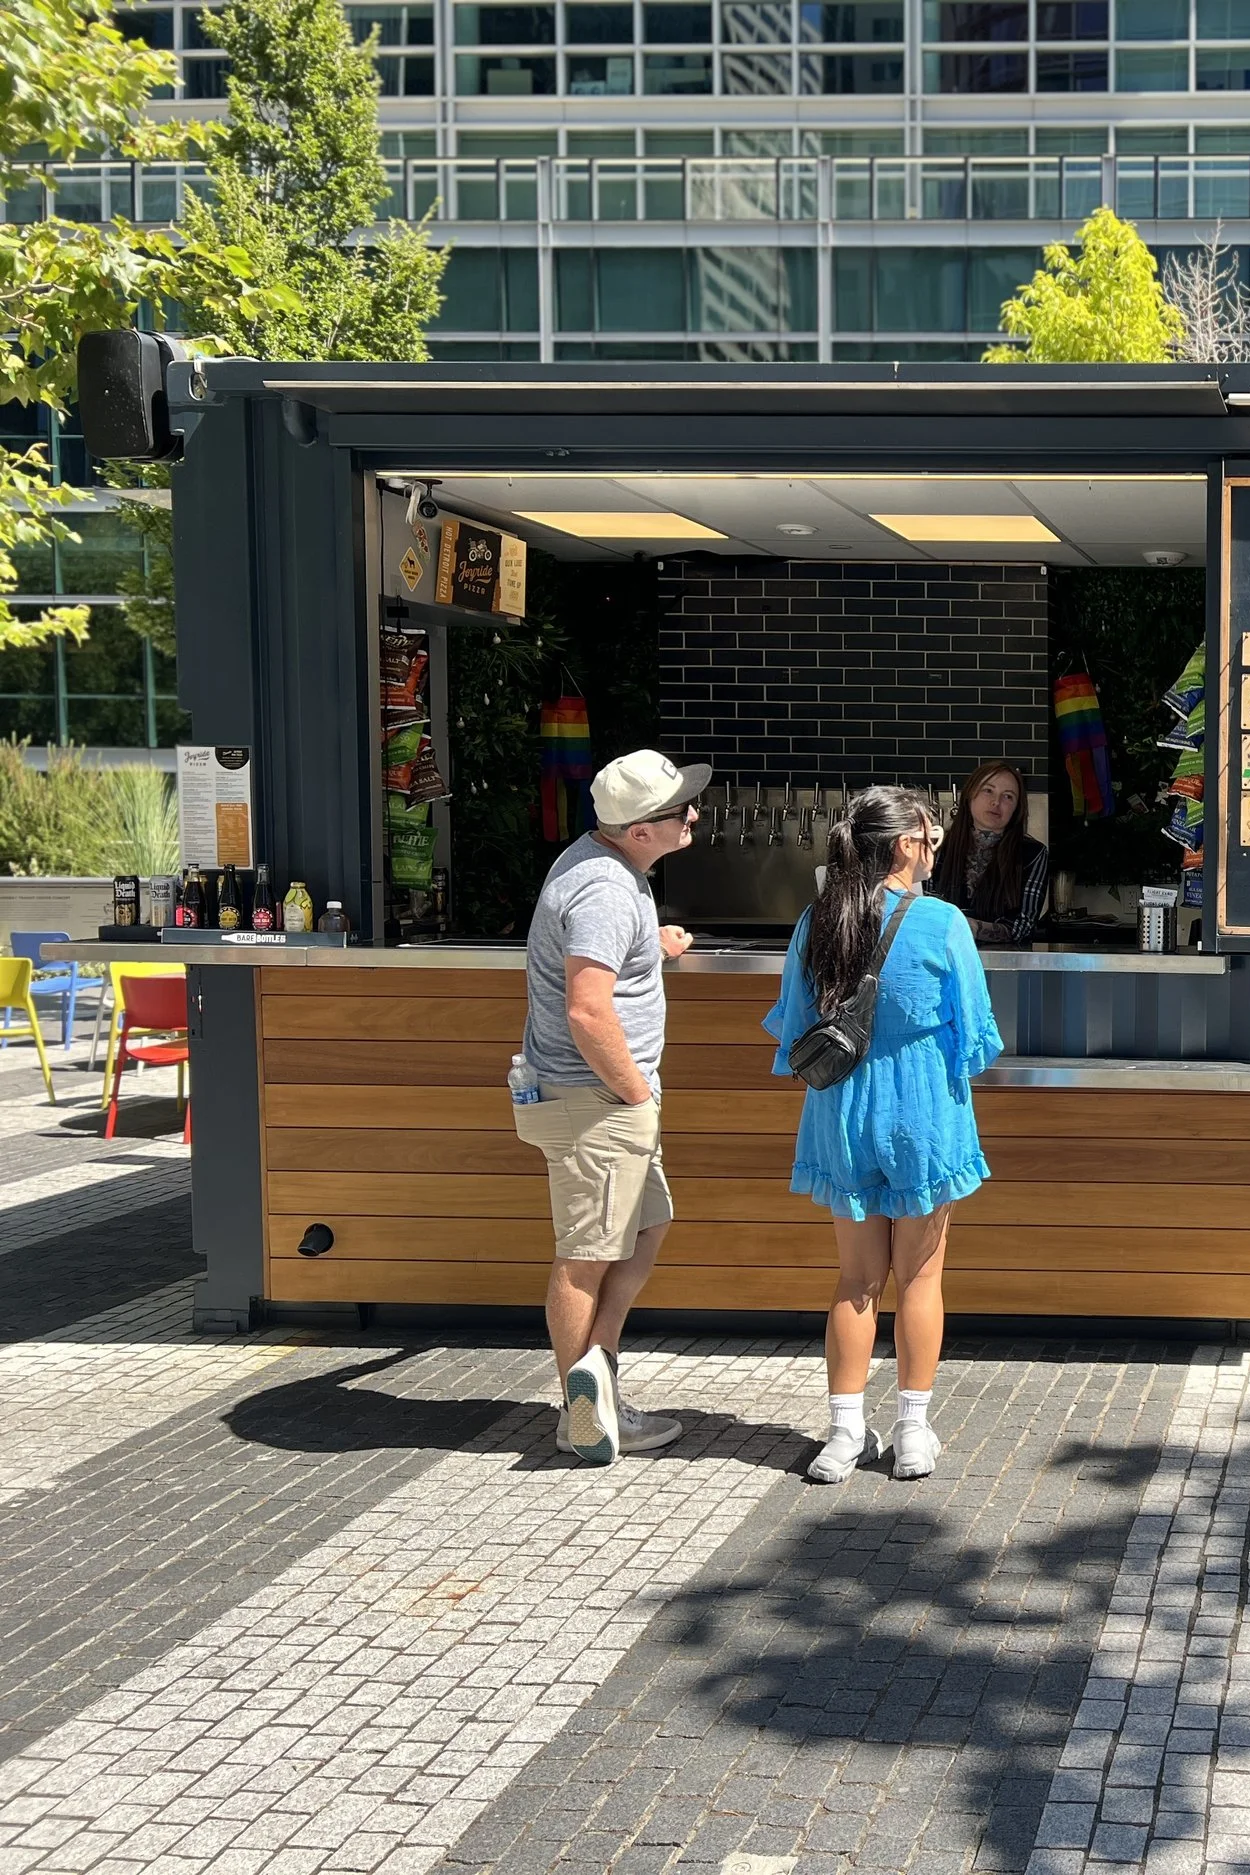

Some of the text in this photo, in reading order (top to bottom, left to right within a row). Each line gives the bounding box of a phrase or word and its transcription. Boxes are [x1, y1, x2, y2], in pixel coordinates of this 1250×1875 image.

[439, 526, 453, 598] HOT DETROIT PIZZA
[457, 560, 493, 583] Joyride
[463, 583, 486, 595] PIZZA
[114, 881, 136, 891] Liquid
[150, 883, 170, 892] Liquid
[115, 890, 136, 898] Death
[151, 891, 171, 899] Death
[236, 934, 280, 943] BARE BOTTLE
